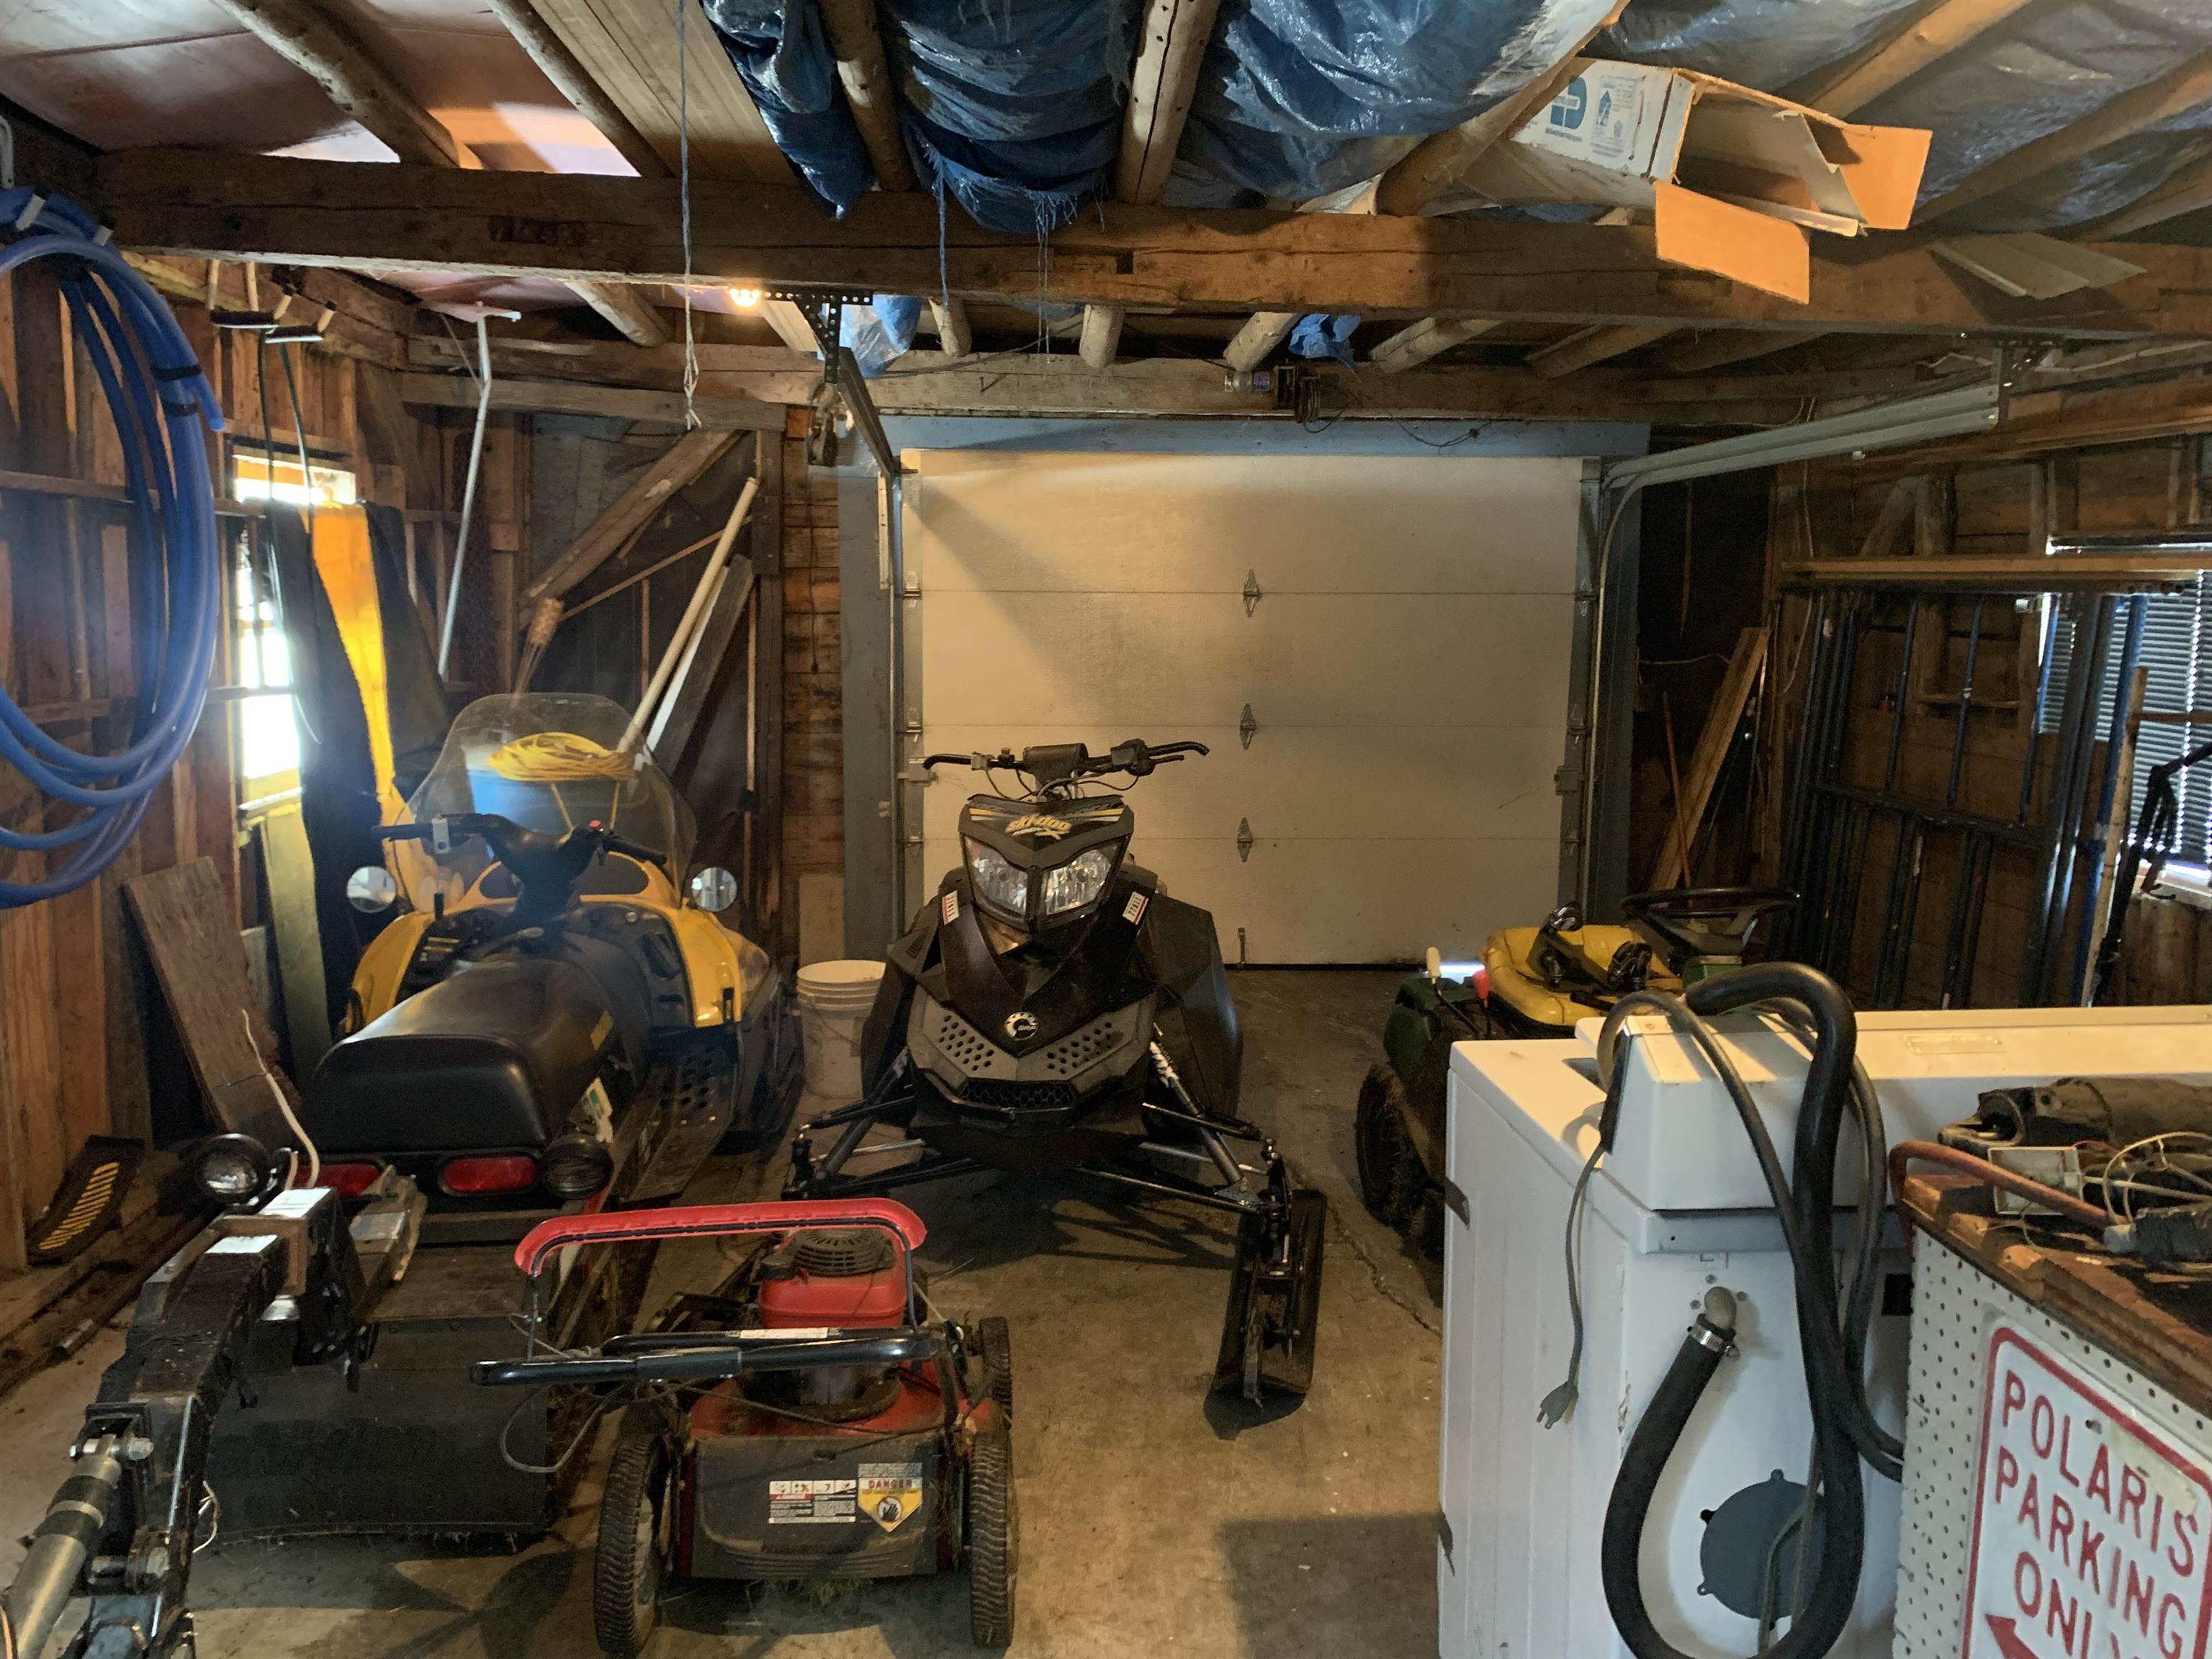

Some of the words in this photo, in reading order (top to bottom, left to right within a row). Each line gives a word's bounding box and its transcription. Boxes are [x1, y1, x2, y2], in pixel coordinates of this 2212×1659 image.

[868, 1479, 912, 1489] DANGER
[1995, 1444, 2186, 1659] PARKING
[2002, 1369, 2198, 1578] POLARIS
[2014, 1550, 2141, 1659] ONL
